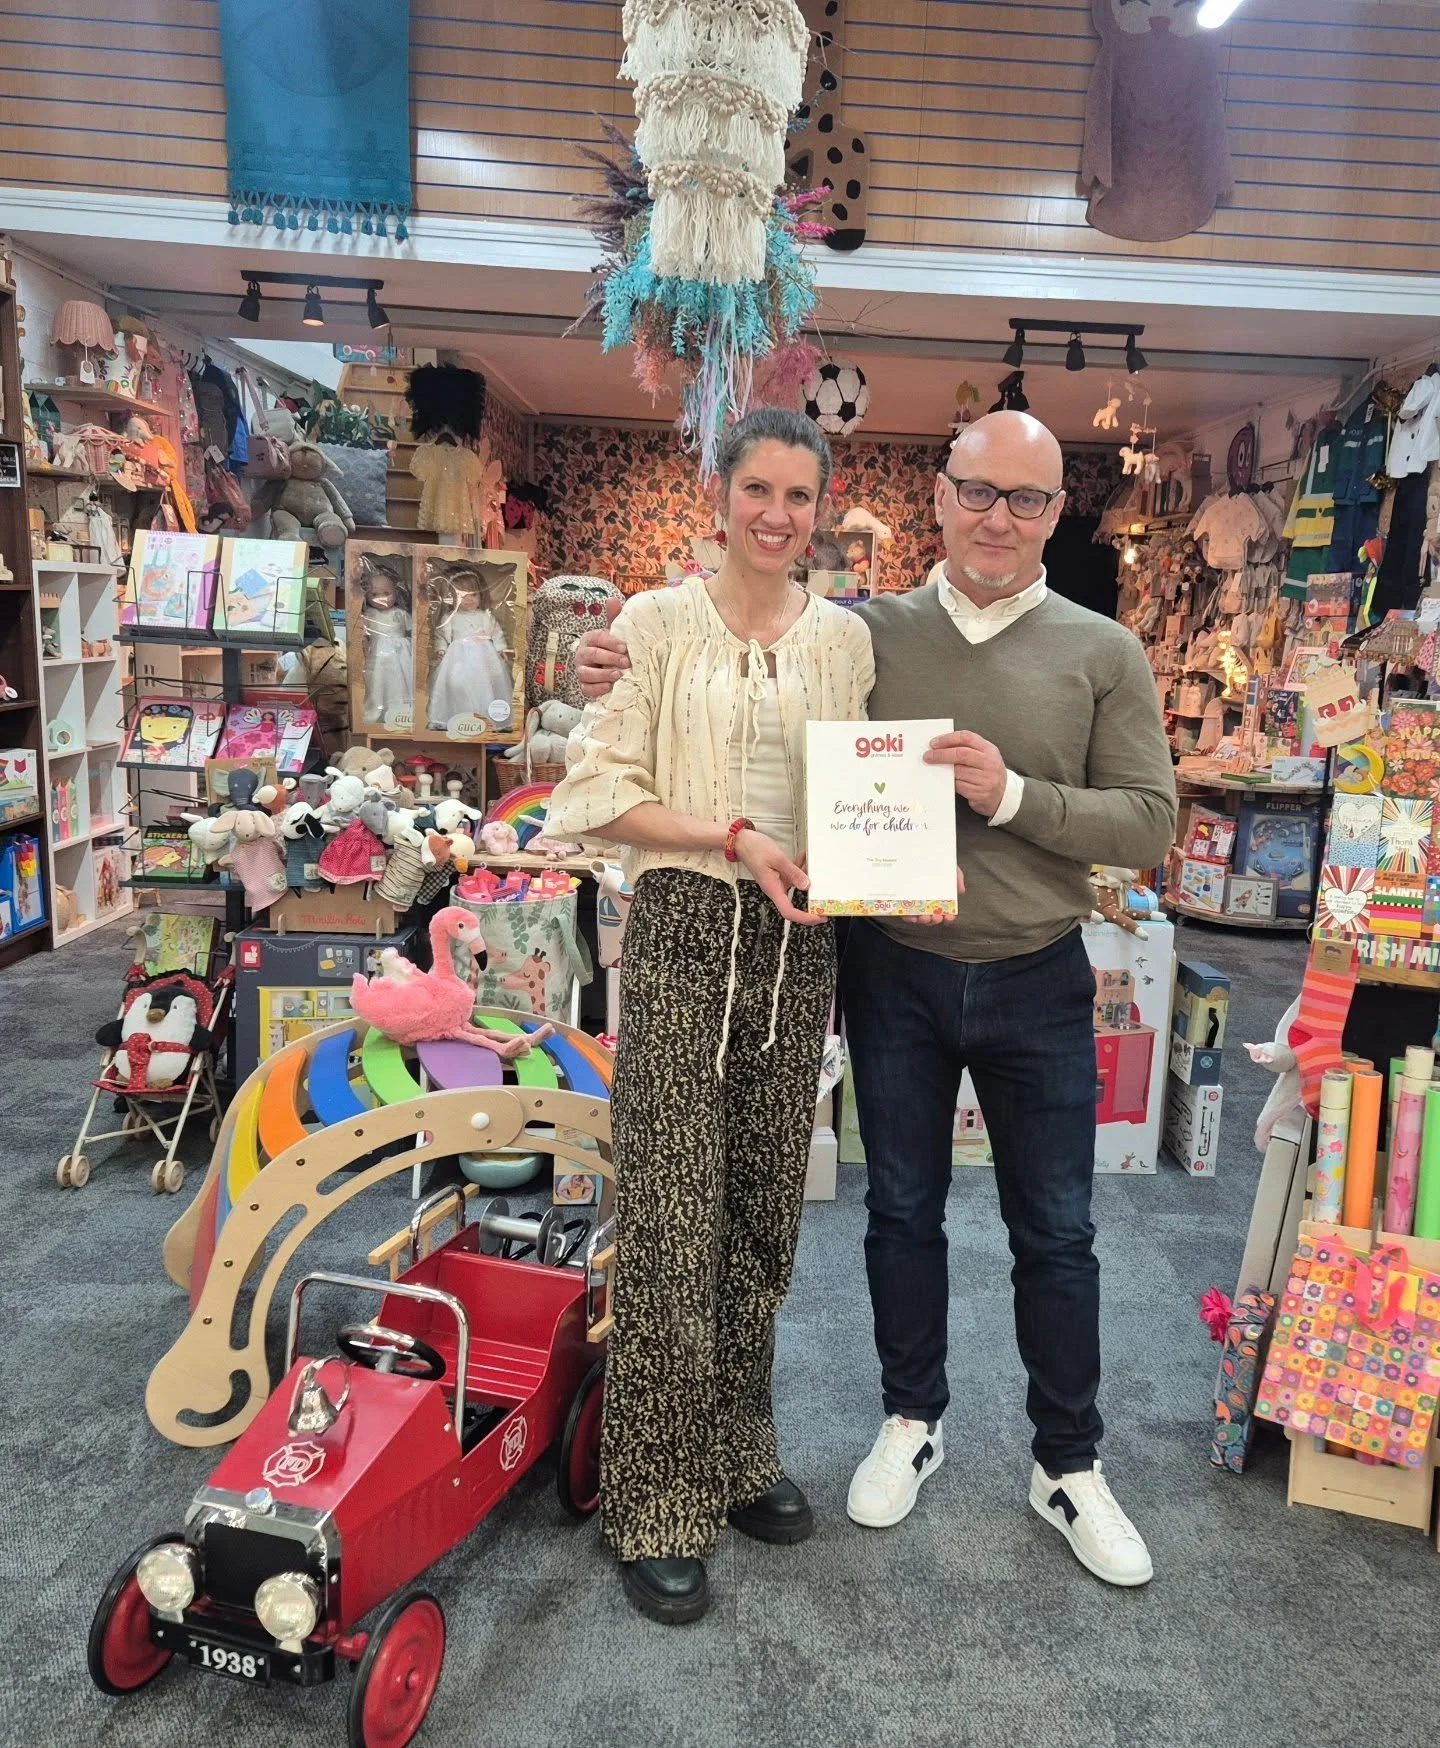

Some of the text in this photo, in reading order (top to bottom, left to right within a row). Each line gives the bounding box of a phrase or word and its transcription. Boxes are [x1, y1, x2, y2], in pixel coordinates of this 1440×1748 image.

[395, 714, 413, 723] GUC
[458, 723, 482, 732] GUCA
[1400, 726, 1440, 740] HAPP
[855, 733, 903, 758] goki
[834, 799, 891, 817] Everything
[893, 803, 909, 813] we
[1266, 802, 1302, 812] FLIPPER
[830, 820, 847, 830] we
[849, 818, 862, 831] do
[863, 818, 880, 836] for
[146, 832, 188, 840] STICKERS
[1374, 886, 1424, 899] SLAINTE
[874, 902, 891, 911] goki
[1357, 938, 1407, 961] RISH
[1410, 945, 1440, 967] MI
[198, 1643, 258, 1679] 1938
